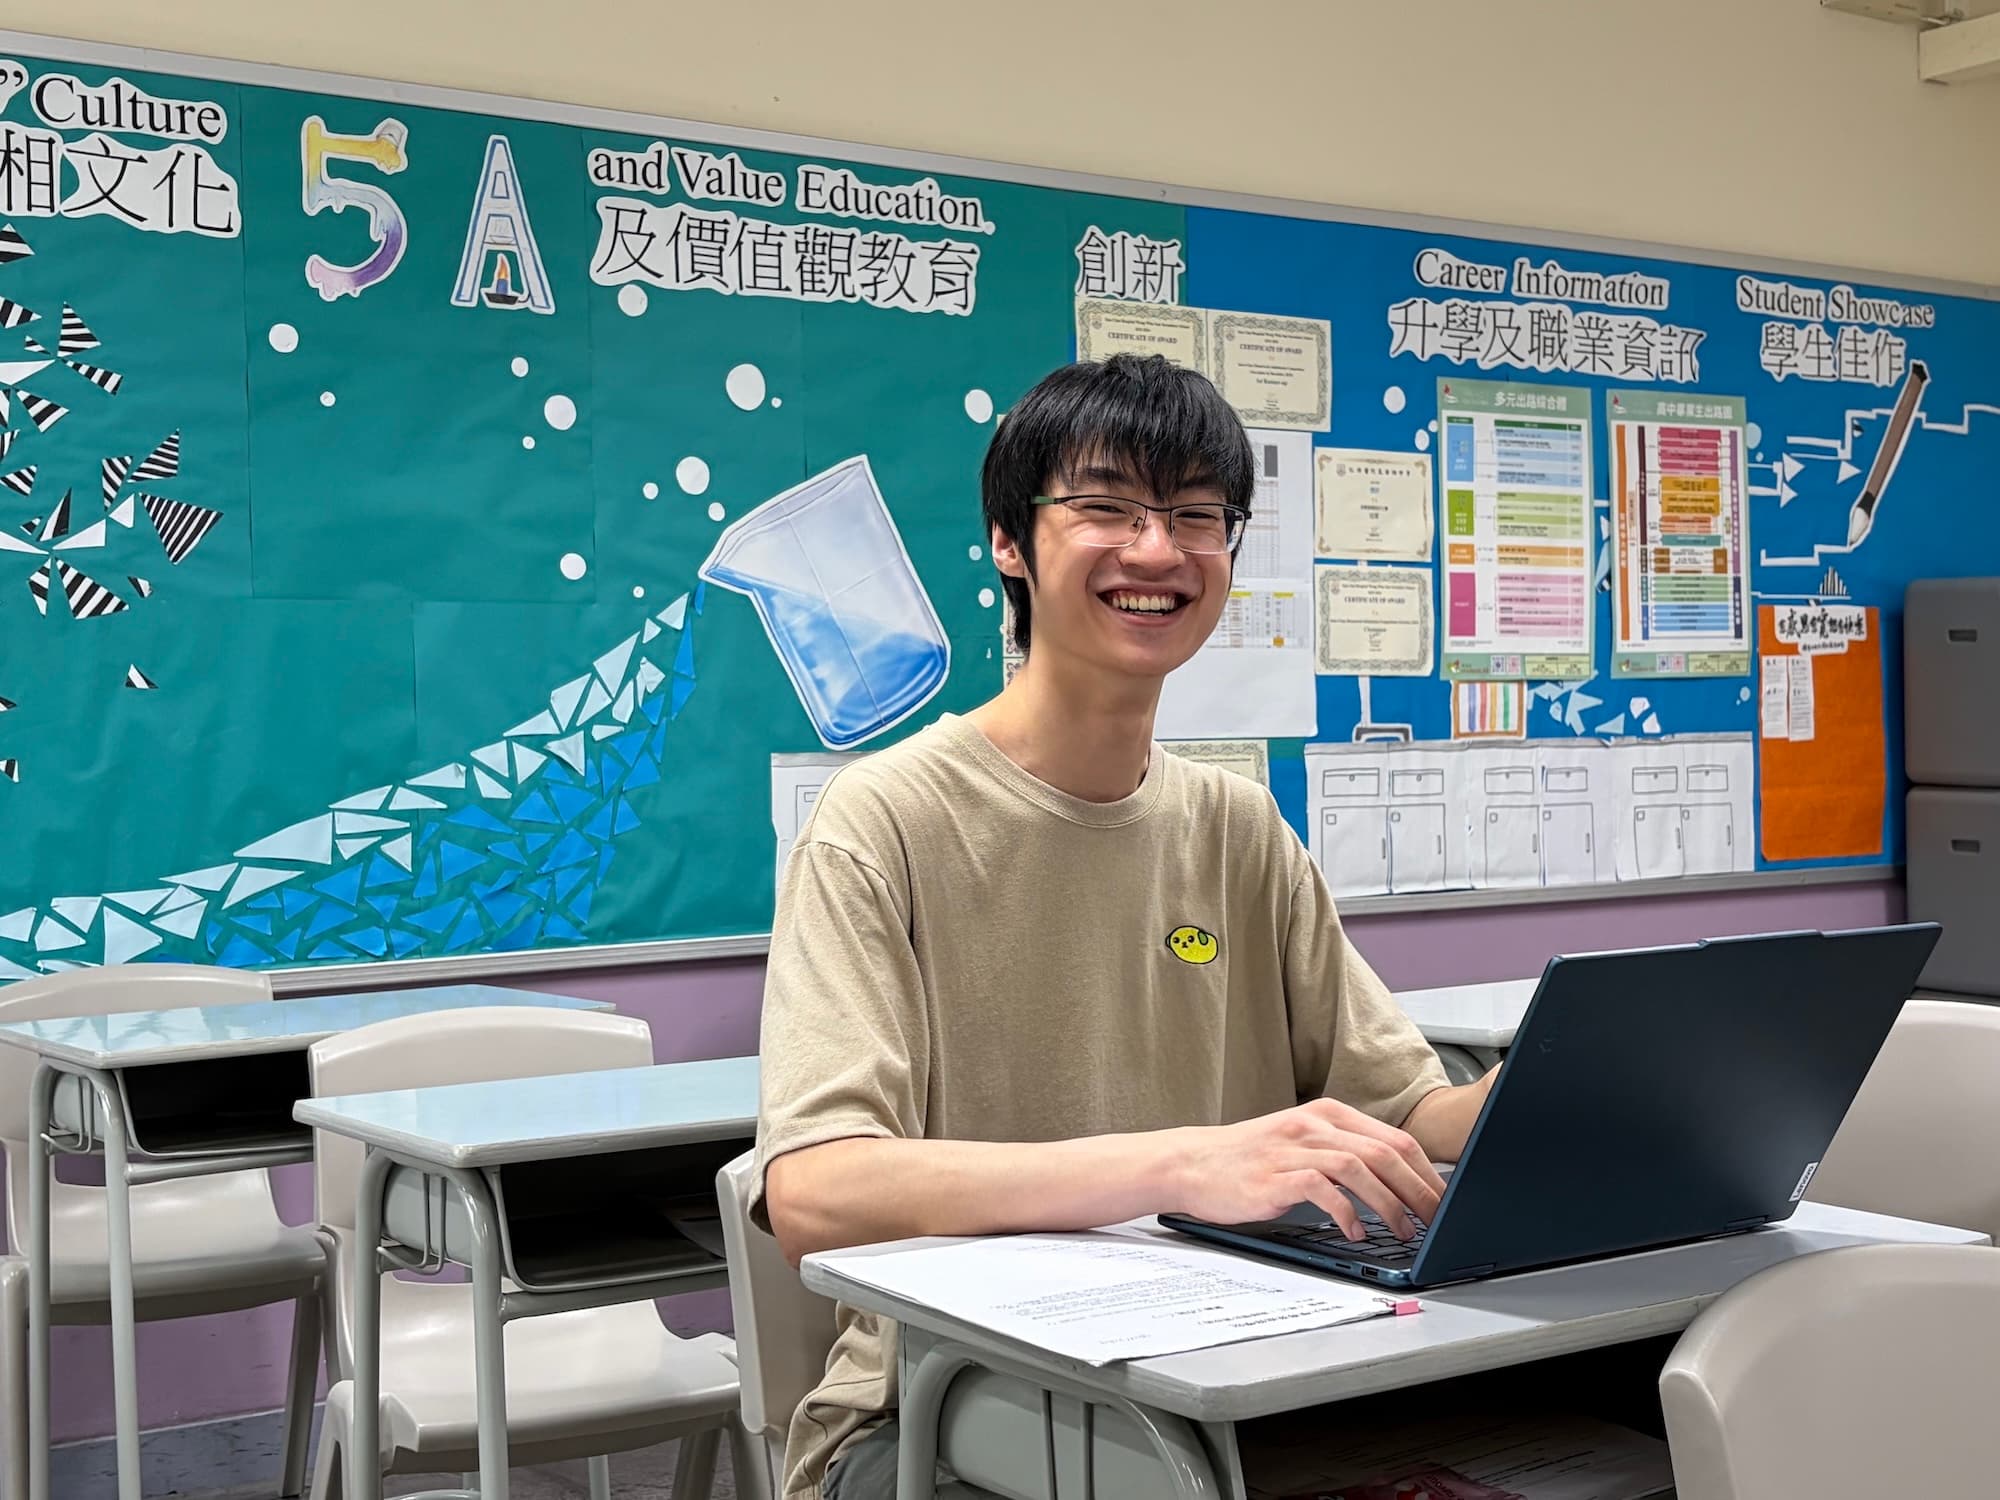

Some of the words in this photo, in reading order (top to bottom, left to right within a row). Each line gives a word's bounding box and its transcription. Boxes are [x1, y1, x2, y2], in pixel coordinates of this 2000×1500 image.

[35, 77, 222, 139] Culture
[0, 129, 235, 234] 相文化
[592, 146, 667, 191] and
[672, 150, 785, 204] Value
[595, 204, 979, 311] 及價值觀教育
[1076, 230, 1184, 304] 創新
[1414, 250, 1505, 292] Career
[1515, 261, 1666, 307] Information
[1738, 276, 1827, 320] Student
[1829, 288, 1935, 327] Showcase
[1390, 298, 1705, 382] 升學及職業資訊
[1762, 322, 1905, 385] 學生佳作
